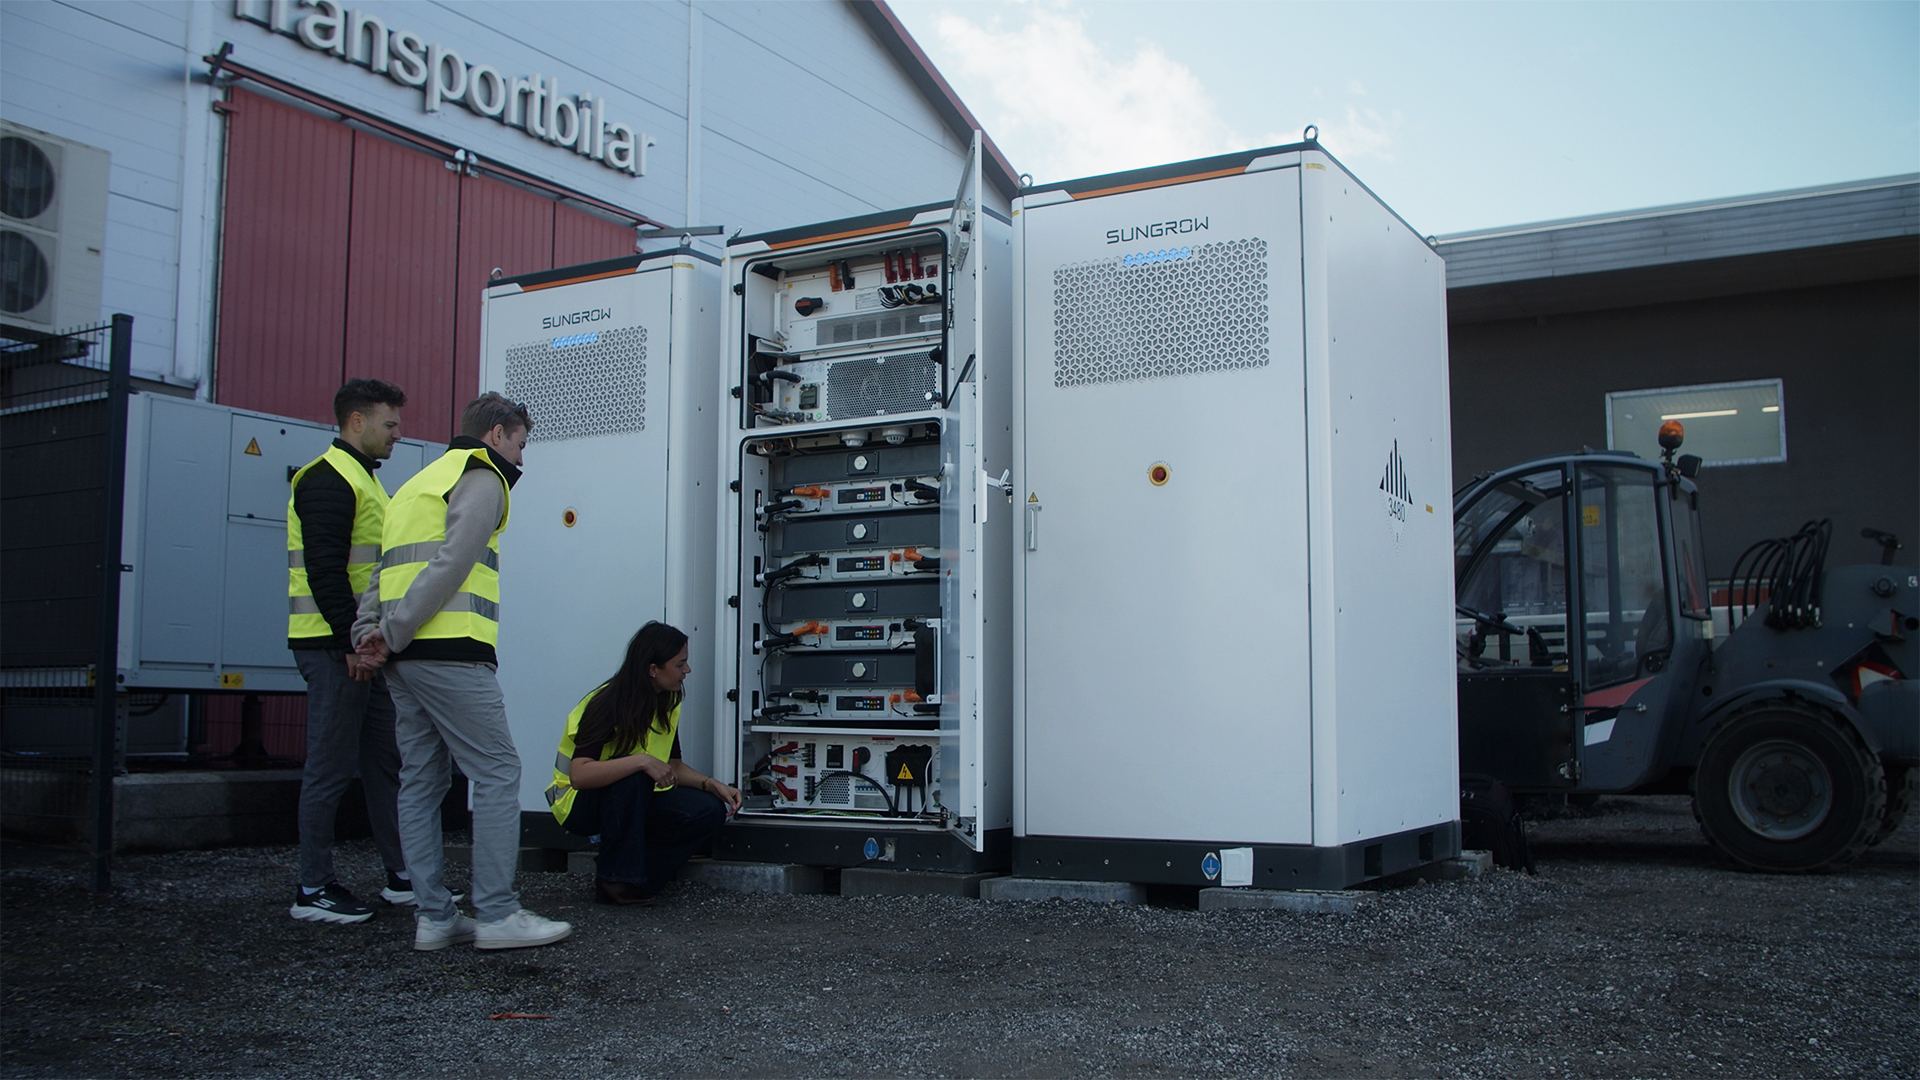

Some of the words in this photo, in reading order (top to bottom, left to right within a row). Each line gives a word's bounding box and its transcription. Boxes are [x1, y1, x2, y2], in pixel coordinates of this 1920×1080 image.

[236, 0, 656, 177] ansportbilar
[1106, 216, 1209, 245] SUNGROW
[542, 307, 611, 330] SUNGROW
